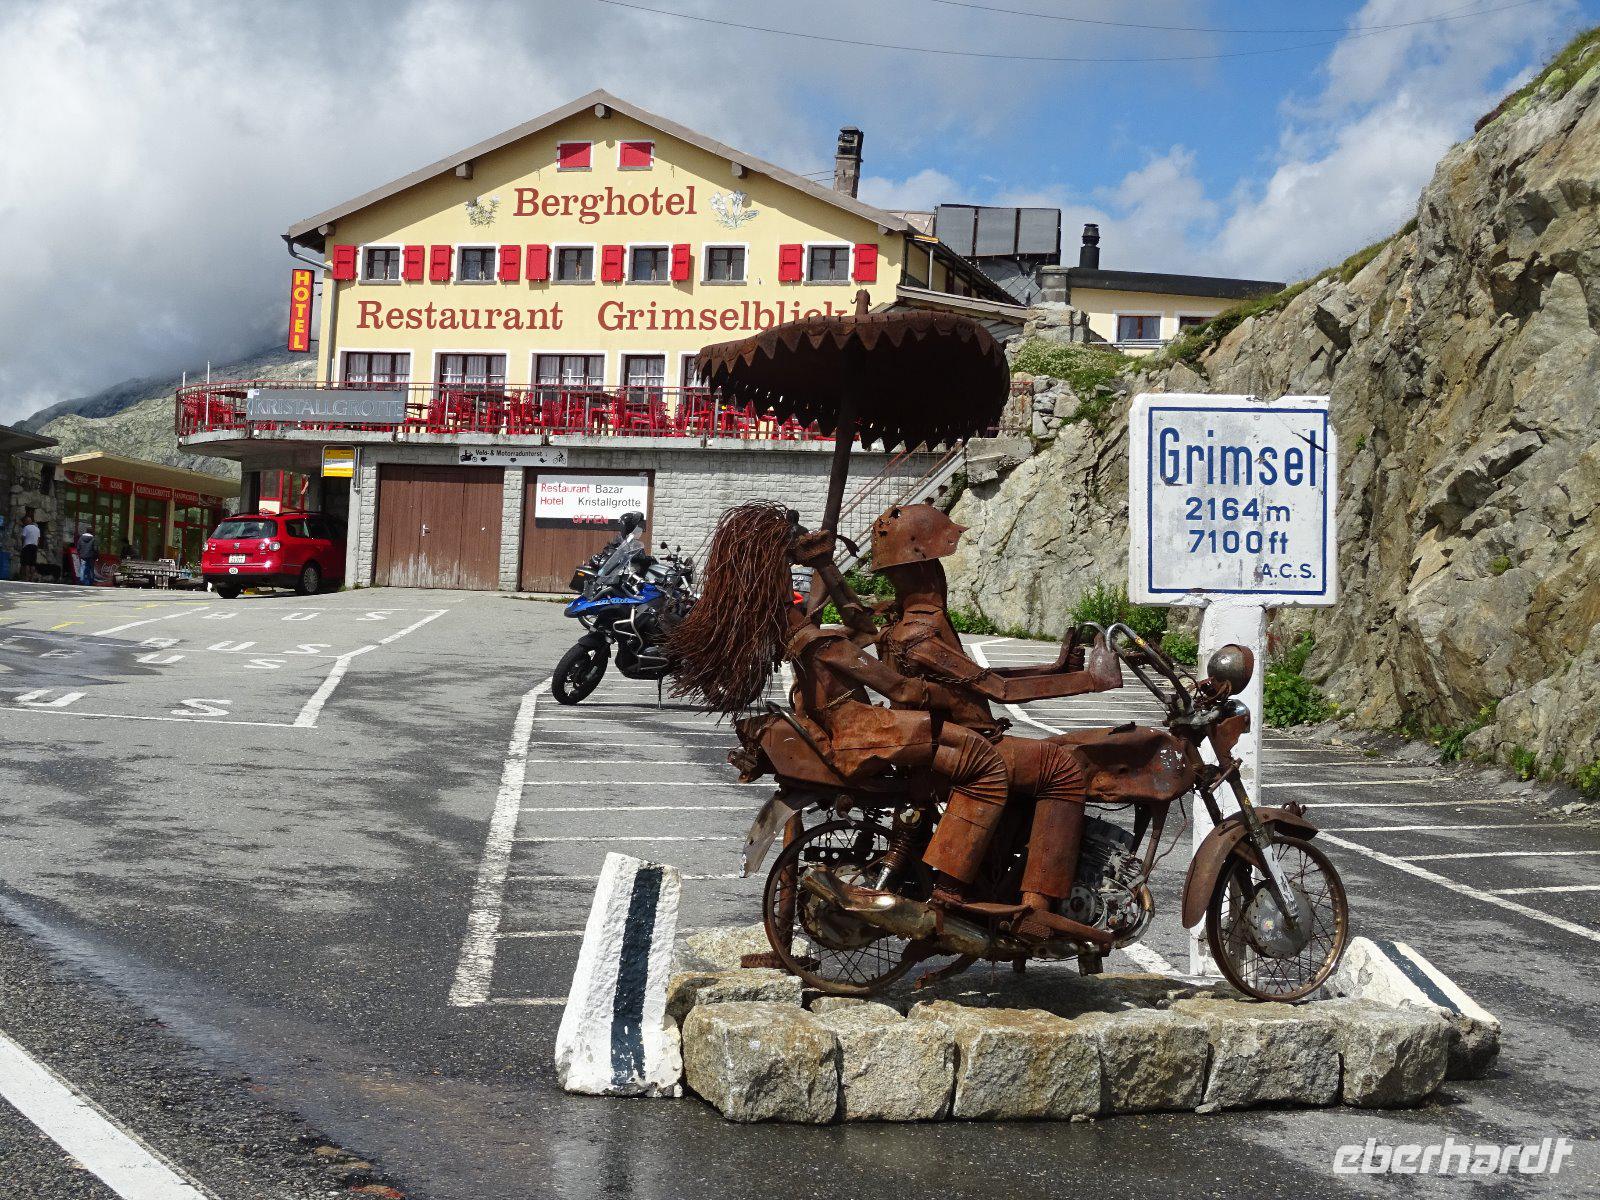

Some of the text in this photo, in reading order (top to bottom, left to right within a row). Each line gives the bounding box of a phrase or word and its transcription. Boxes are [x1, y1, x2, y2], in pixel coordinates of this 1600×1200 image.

[513, 186, 698, 225] Berghotel
[293, 271, 310, 349] HOTEL
[356, 300, 564, 330] Restaurant
[1158, 427, 1317, 487] Grimsel
[540, 482, 624, 494] Restaurant Bazar
[540, 496, 642, 509] Hotel Kristallgrotte
[1185, 497, 1260, 522] 2164
[572, 514, 609, 525] OFFEN
[1189, 529, 1289, 555] 7100 ft
[1261, 563, 1316, 579] A.C.S.
